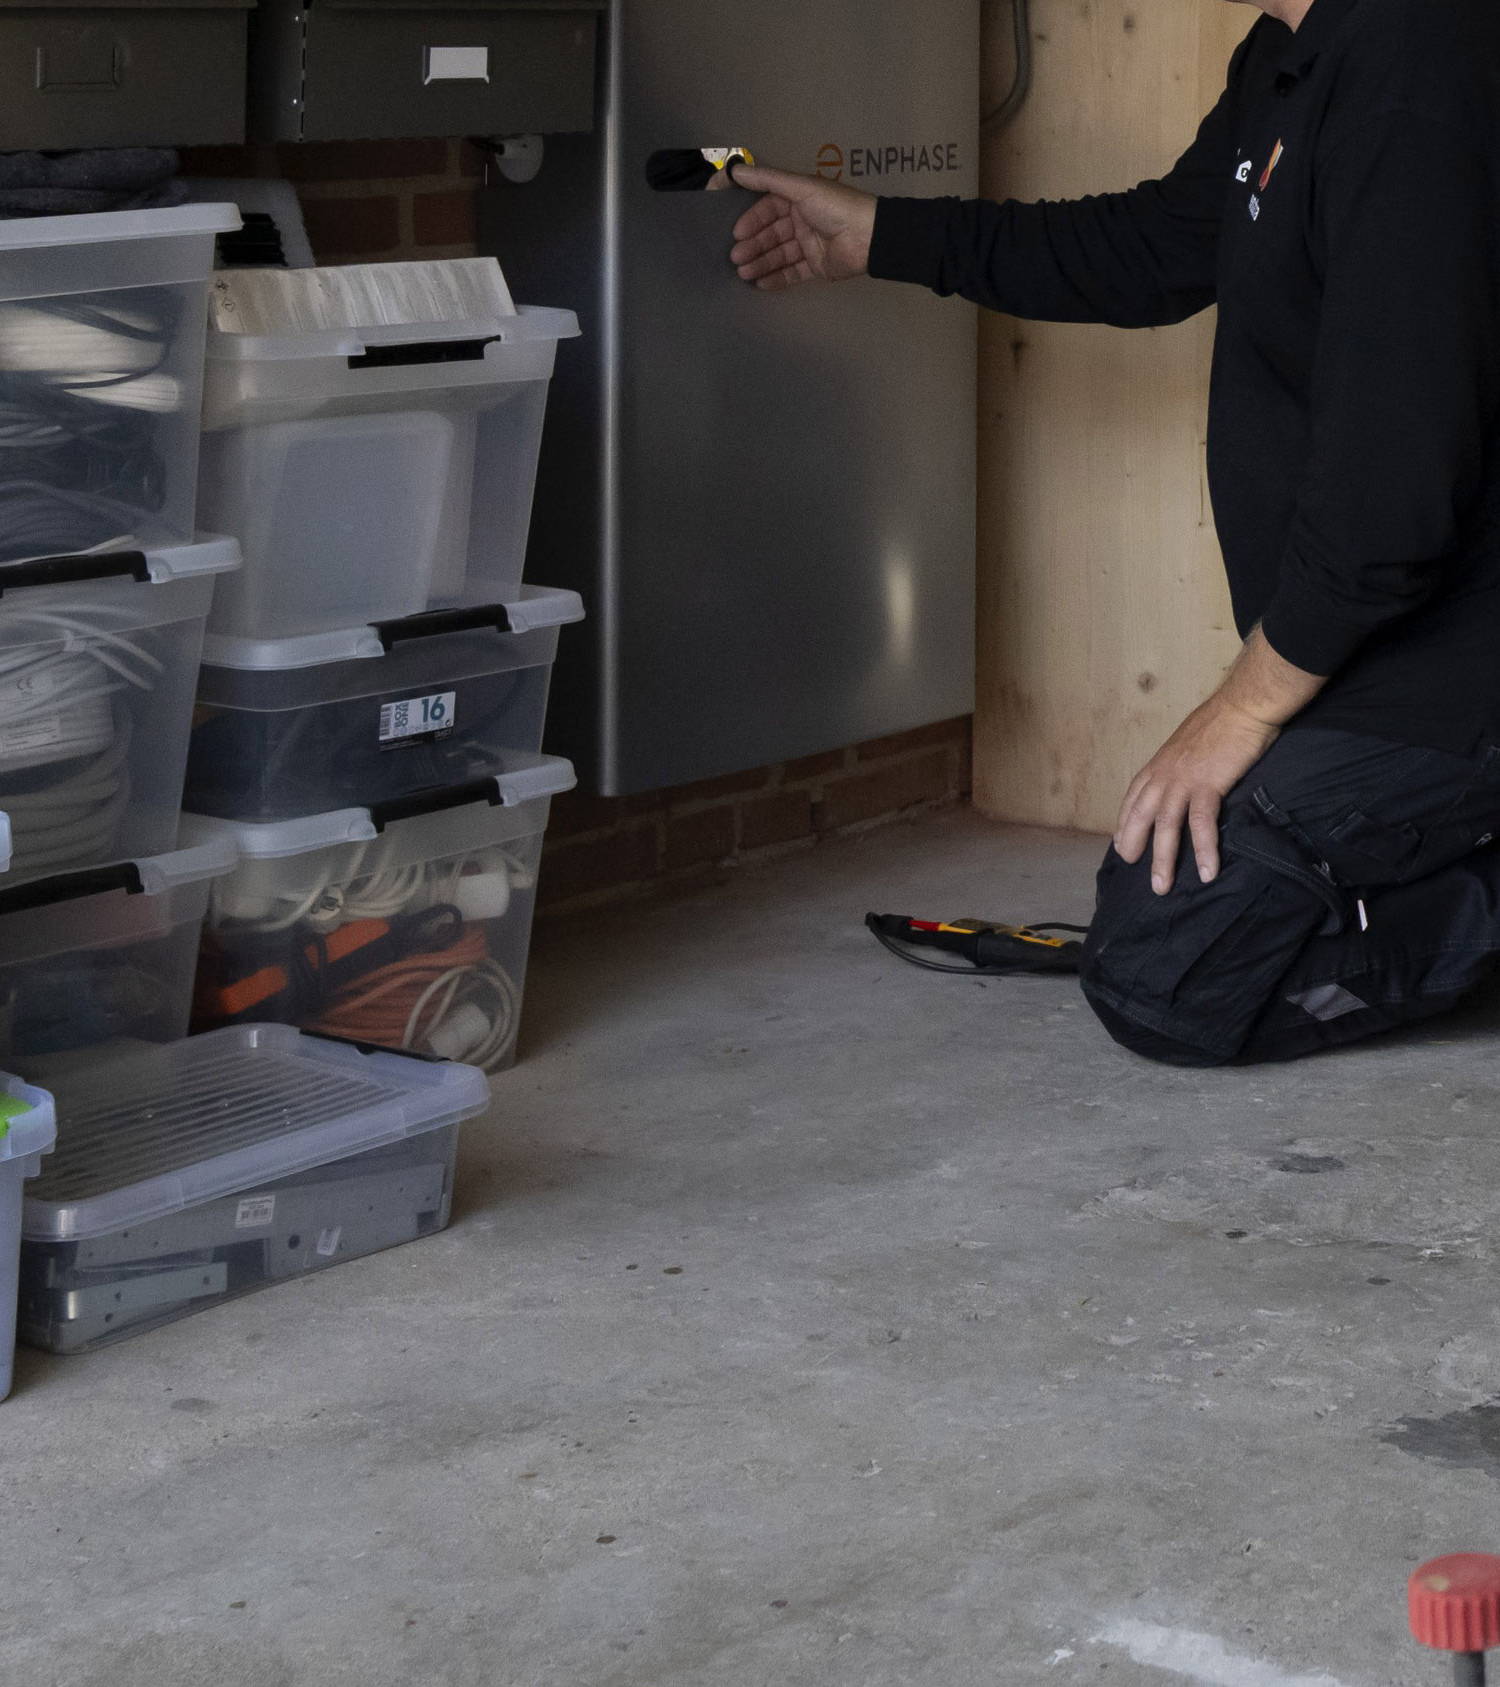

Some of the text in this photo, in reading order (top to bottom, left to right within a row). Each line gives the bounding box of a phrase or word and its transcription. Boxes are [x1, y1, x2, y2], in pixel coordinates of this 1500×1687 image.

[850, 143, 959, 176] ENPHASE
[401, 701, 410, 727] ONE
[421, 695, 446, 723] 16
